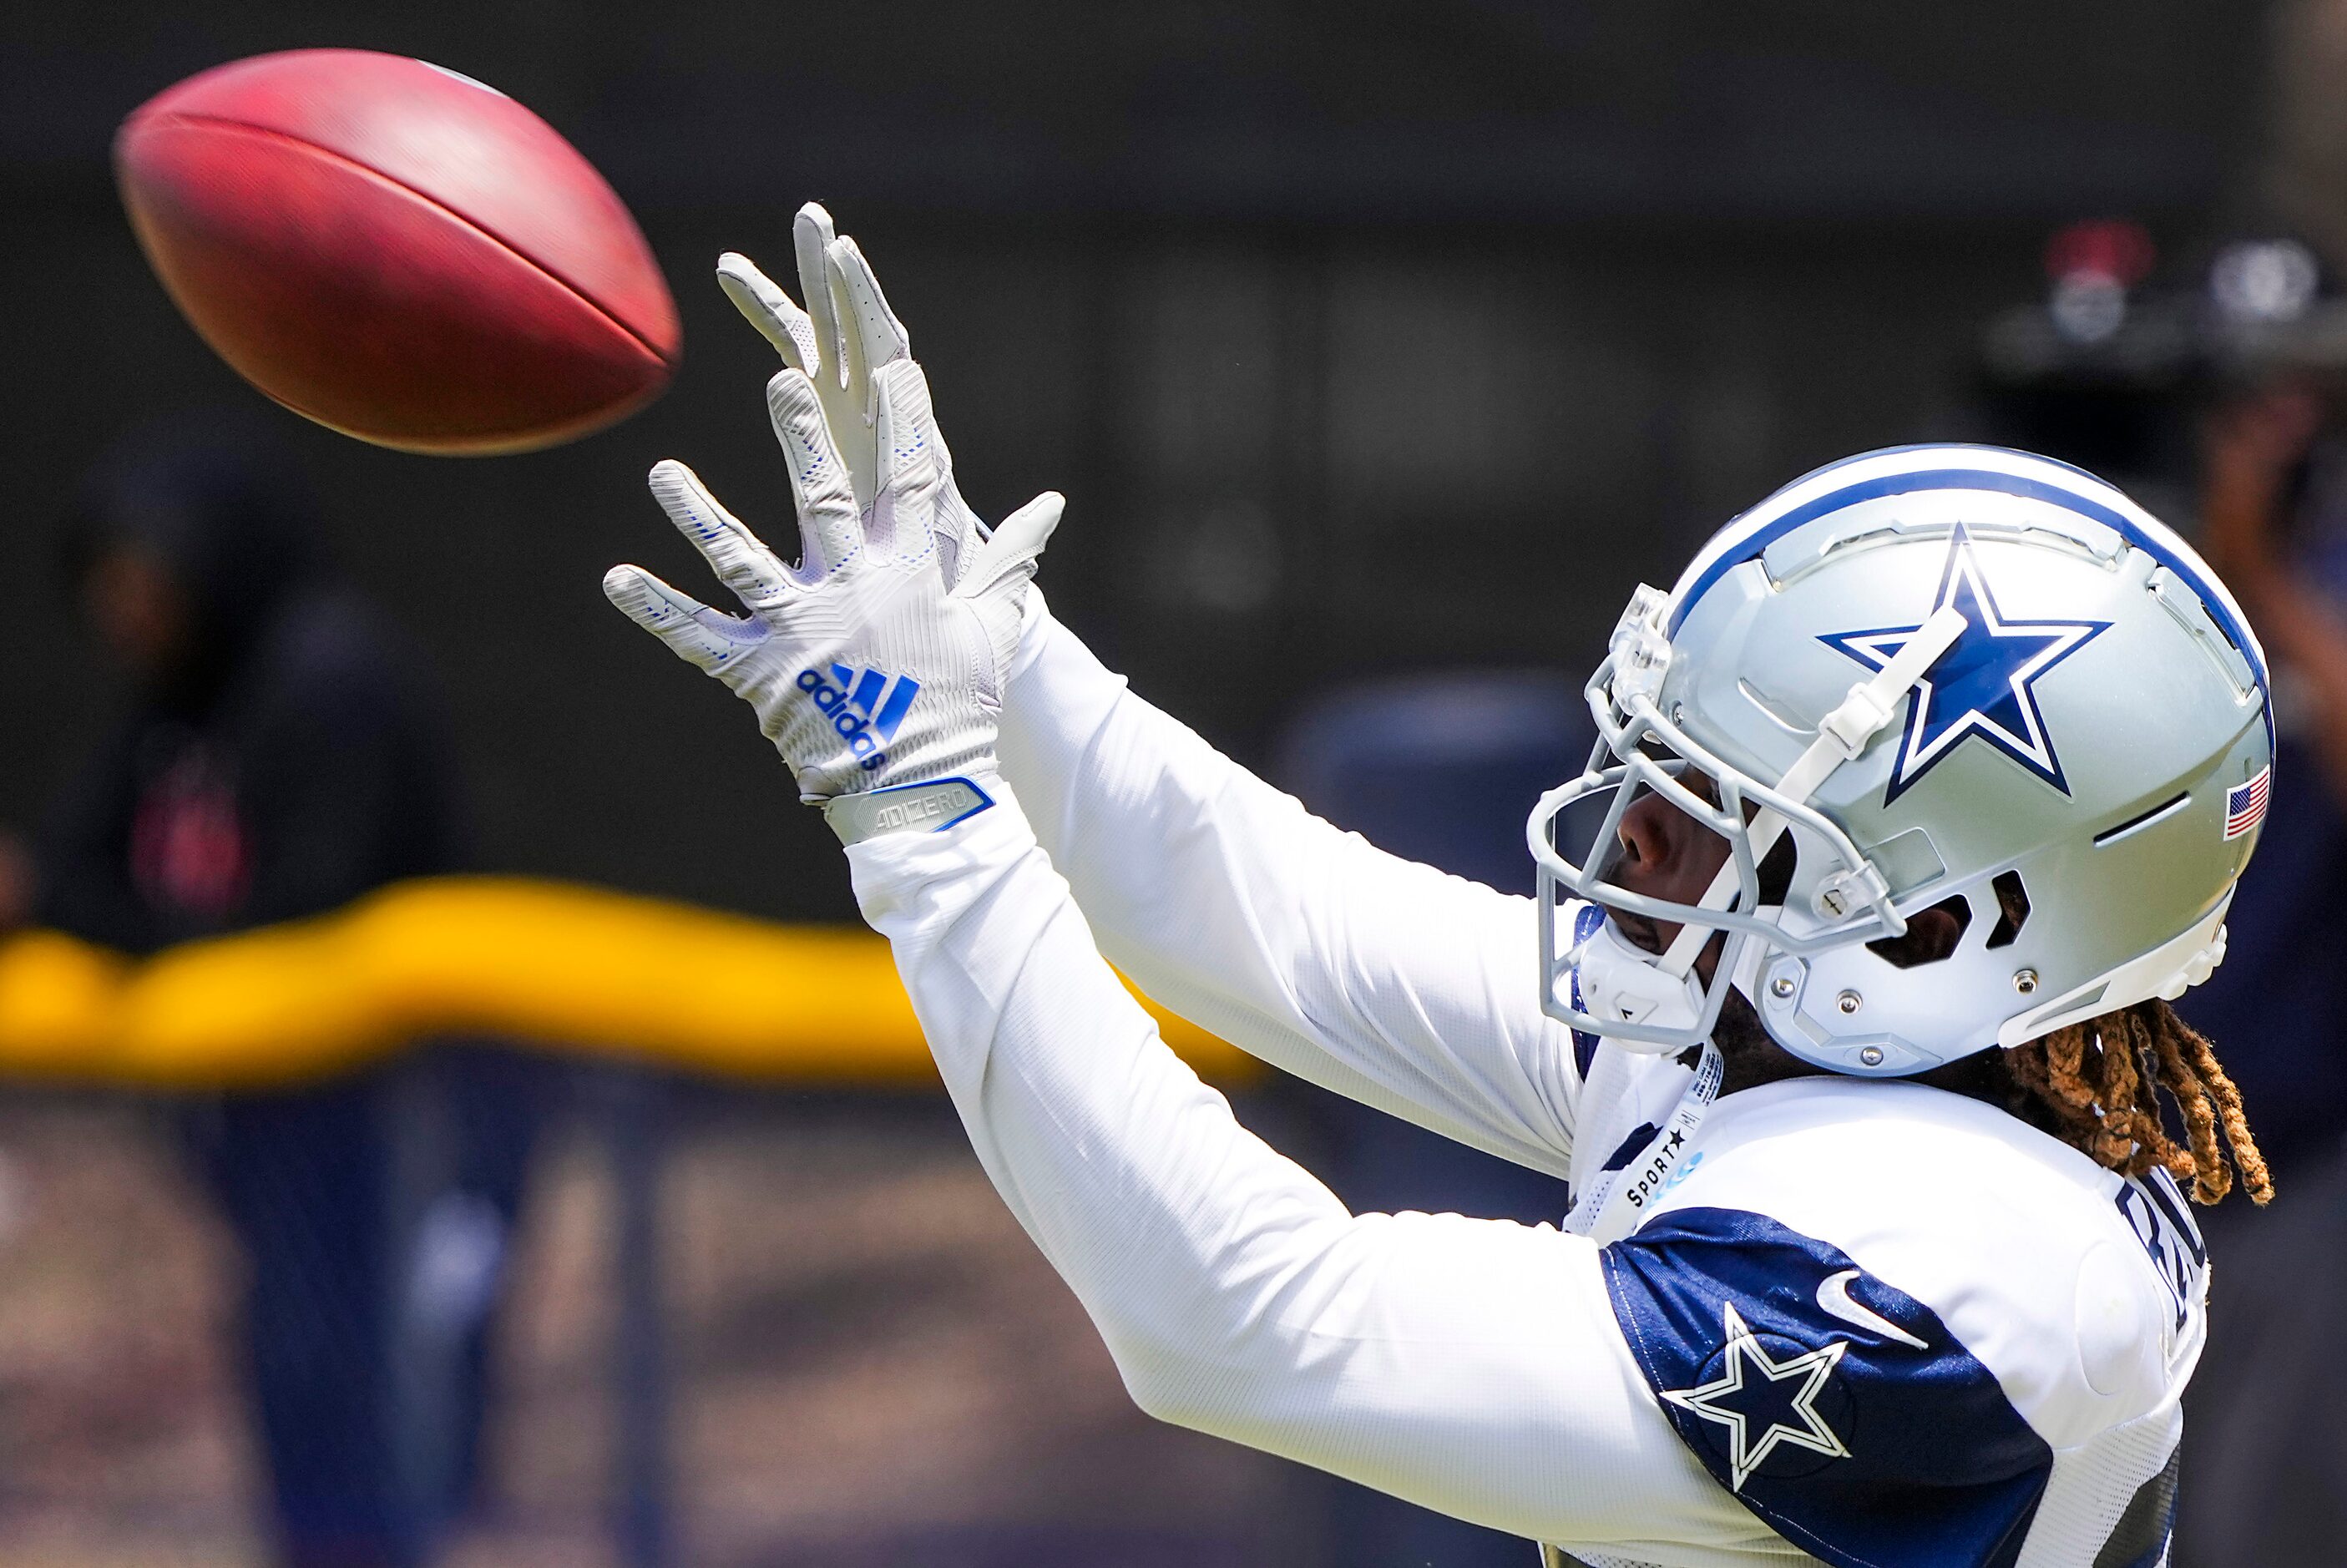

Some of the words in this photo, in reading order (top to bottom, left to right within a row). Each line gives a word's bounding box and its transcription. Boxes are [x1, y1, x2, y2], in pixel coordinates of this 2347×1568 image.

[797, 670, 885, 771] adidas
[878, 789, 966, 829] ADIZERO
[1627, 1145, 1674, 1207] SPORT
